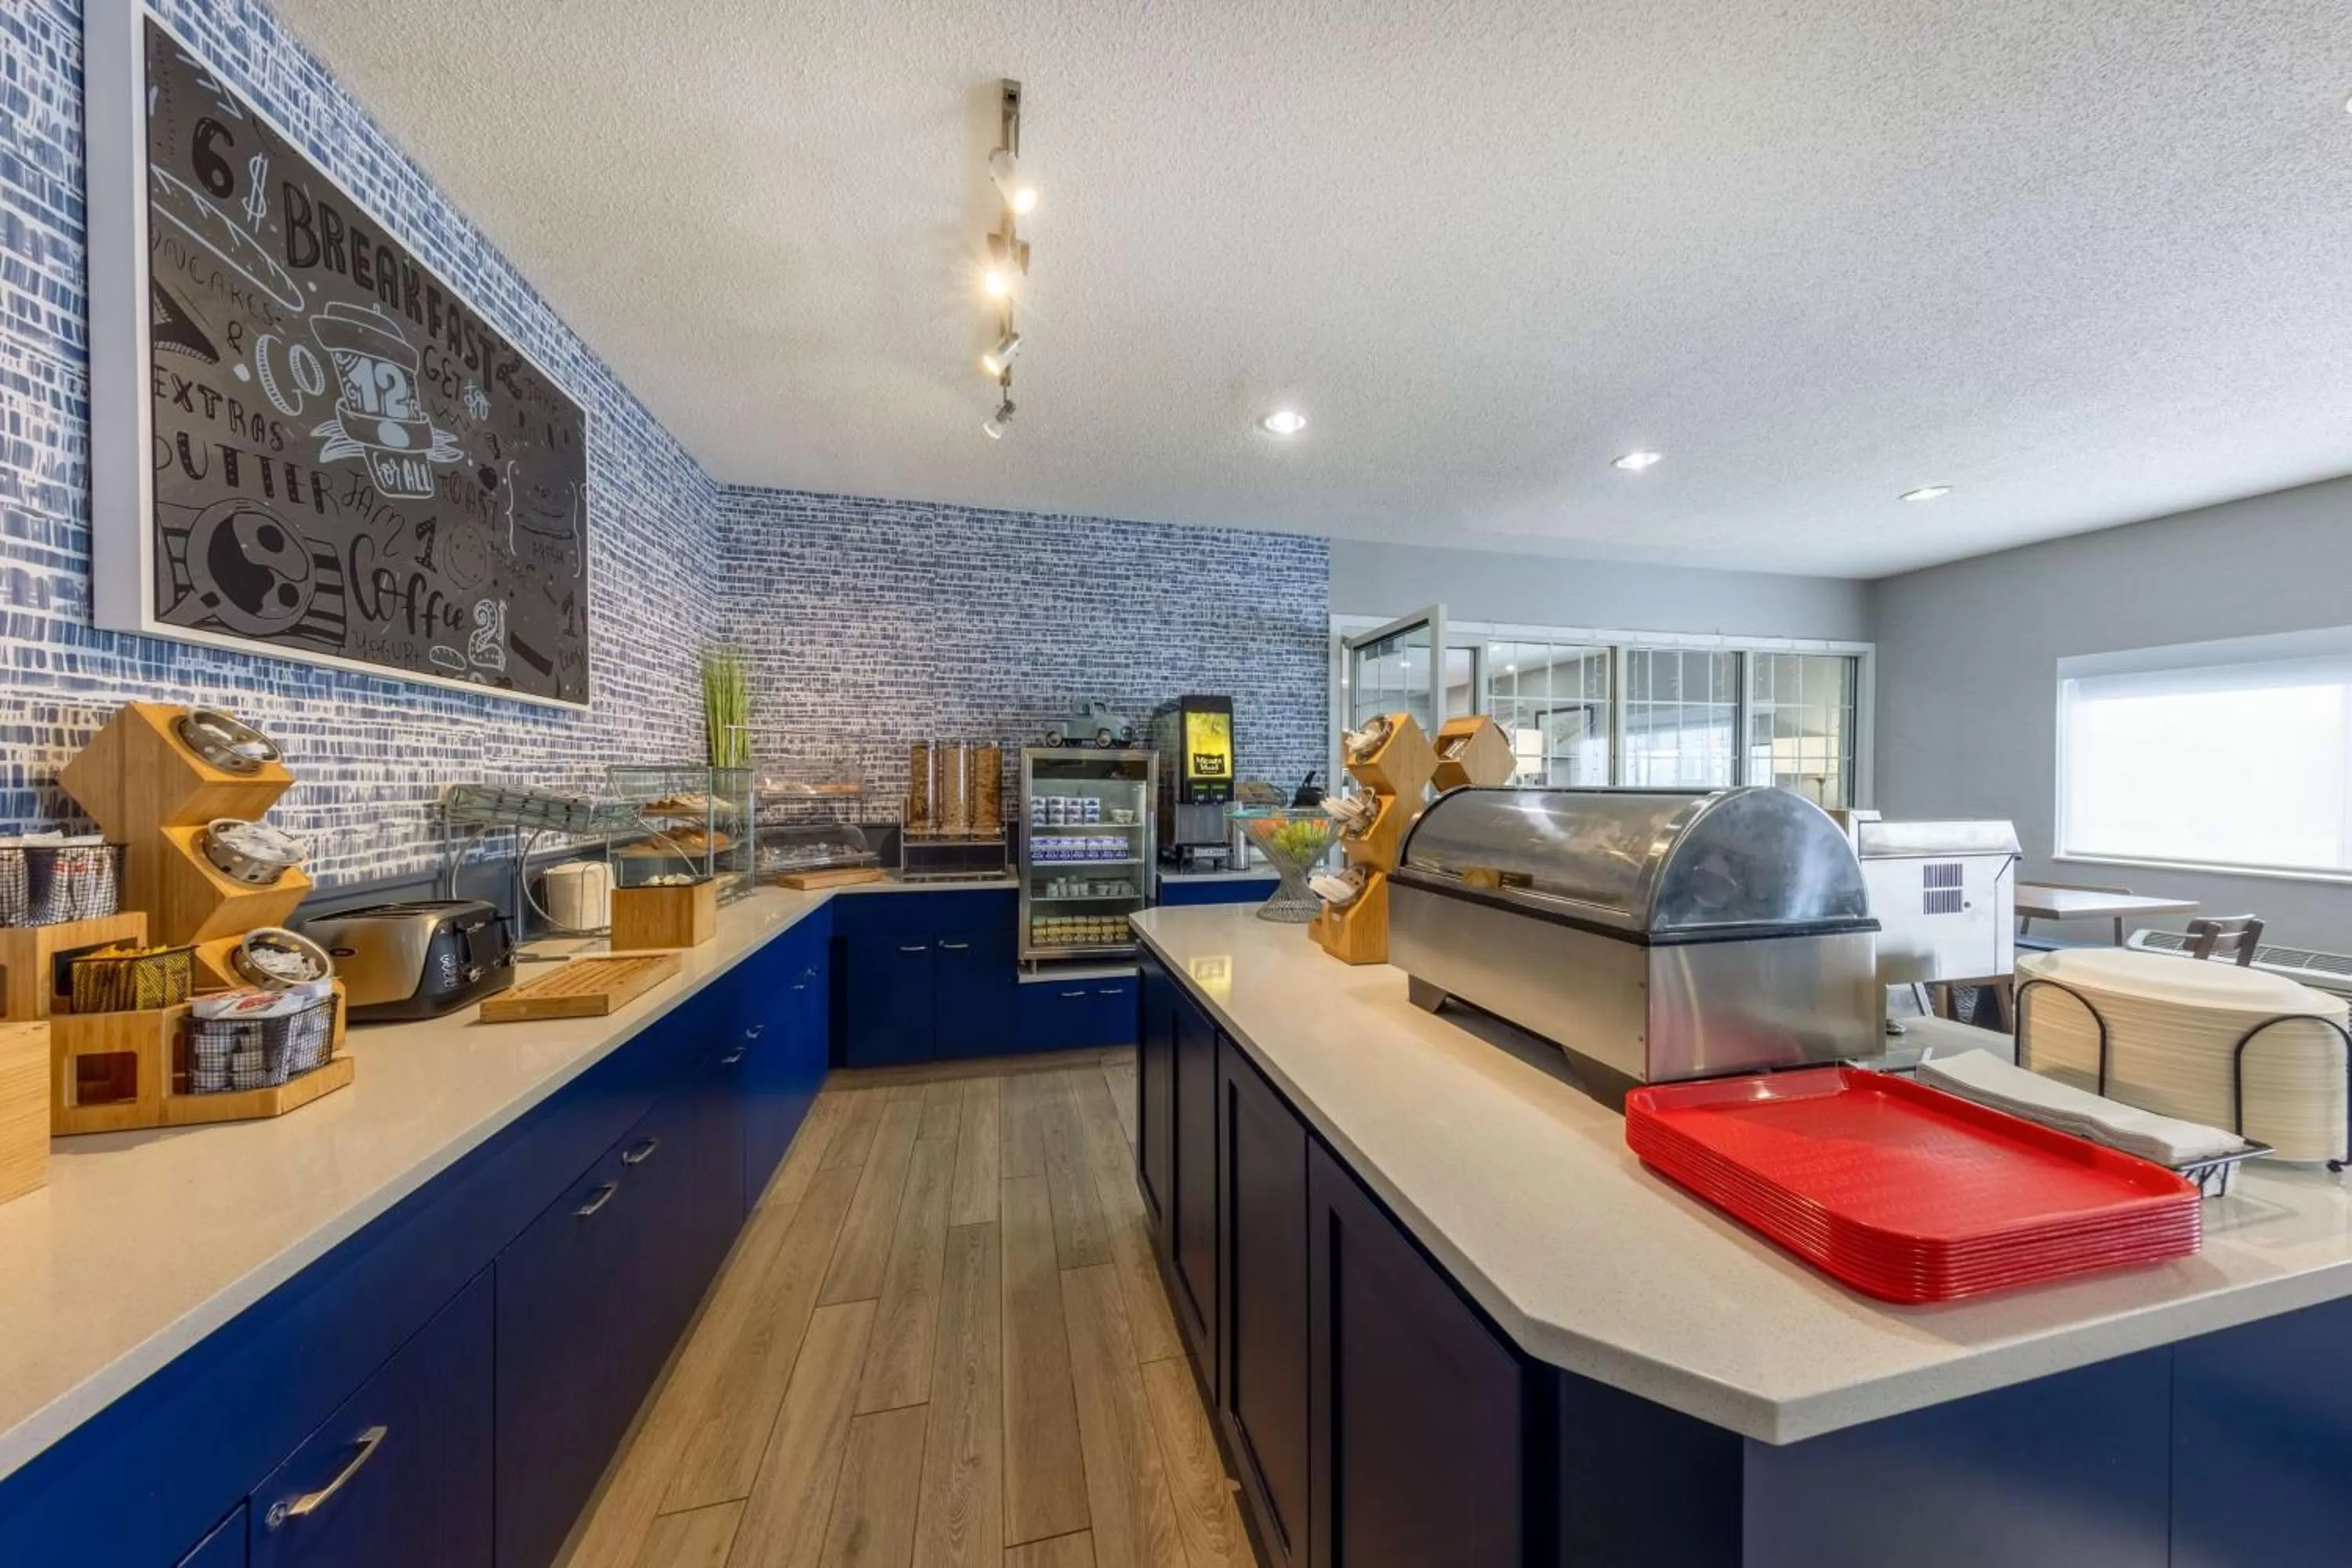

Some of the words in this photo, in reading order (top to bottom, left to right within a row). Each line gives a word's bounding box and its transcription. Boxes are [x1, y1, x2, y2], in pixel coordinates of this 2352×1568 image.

[191, 116, 234, 200] 6
[282, 181, 497, 394] BREAKFAST
[154, 364, 285, 452] EXTRAS
[347, 357, 411, 418] 12
[437, 470, 498, 532] TOAST
[350, 533, 464, 640] Coffee
